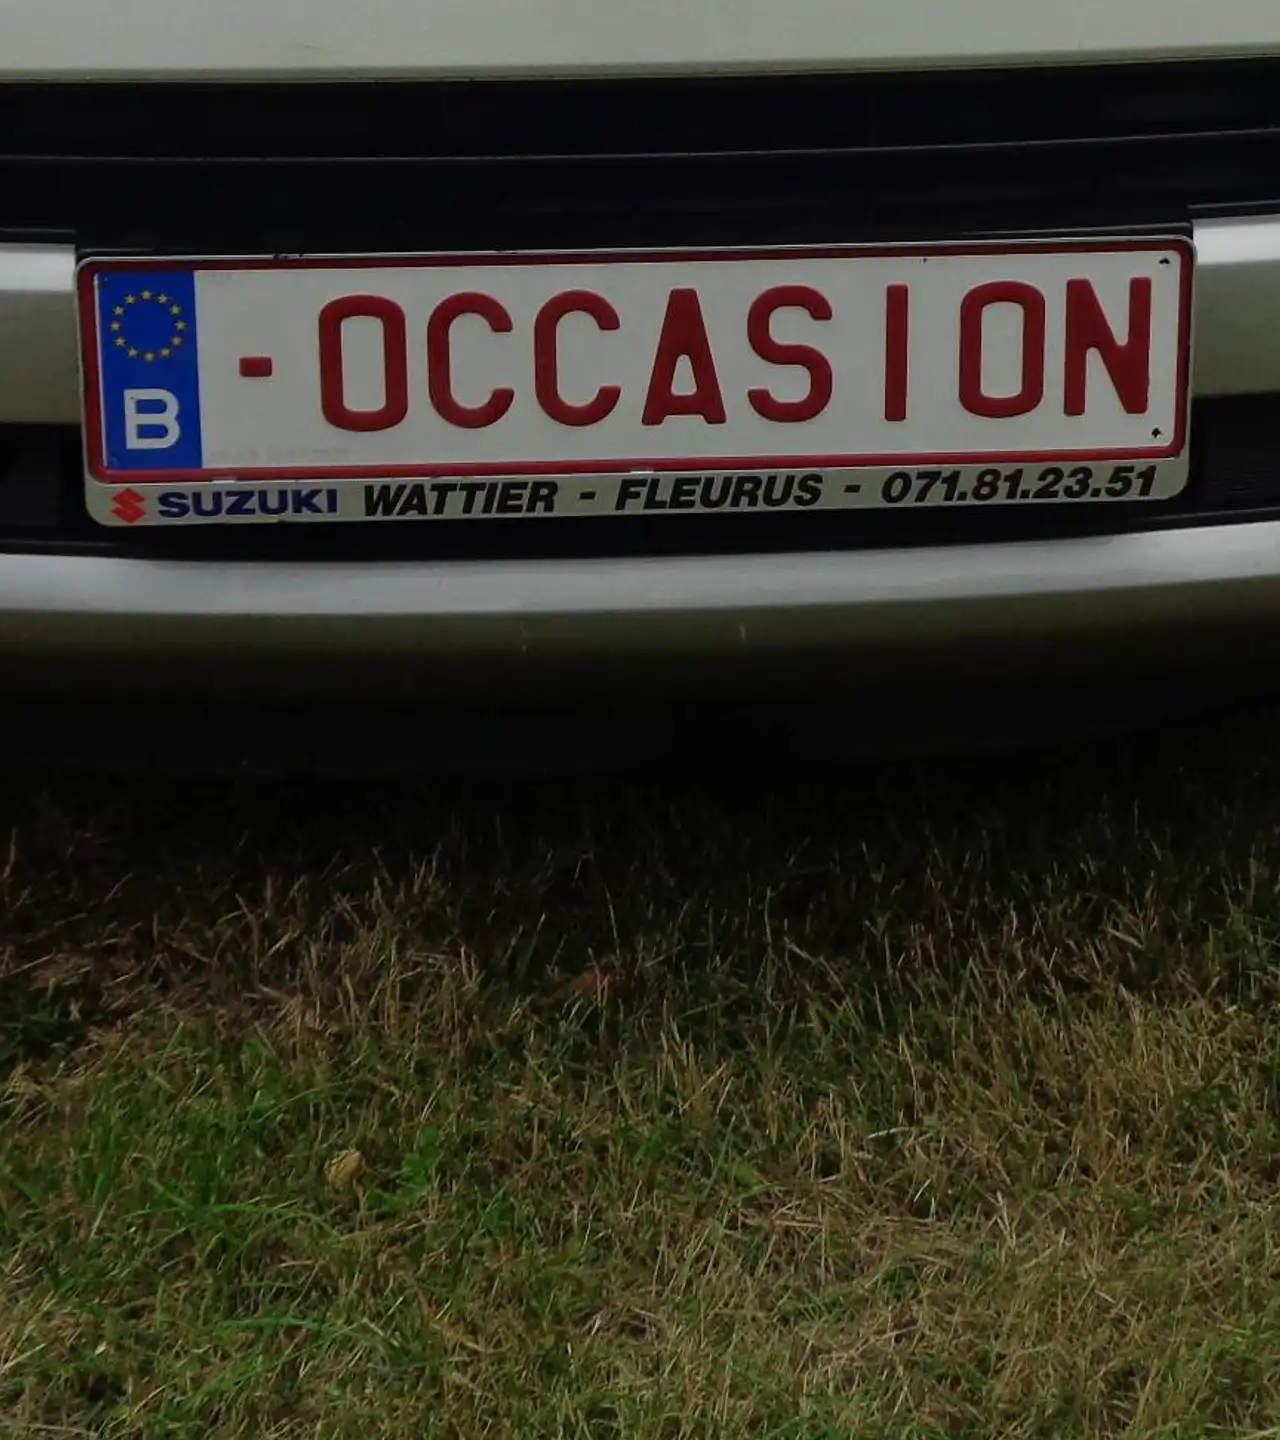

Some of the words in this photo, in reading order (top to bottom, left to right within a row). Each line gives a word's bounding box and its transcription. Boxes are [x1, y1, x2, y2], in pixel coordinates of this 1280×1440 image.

[123, 388, 181, 449] B
[158, 489, 337, 517] SUZUKI
[363, 481, 558, 516] WATTIER
[615, 473, 823, 510] FLEURUS
[881, 464, 1156, 504] 071.81.23.51
